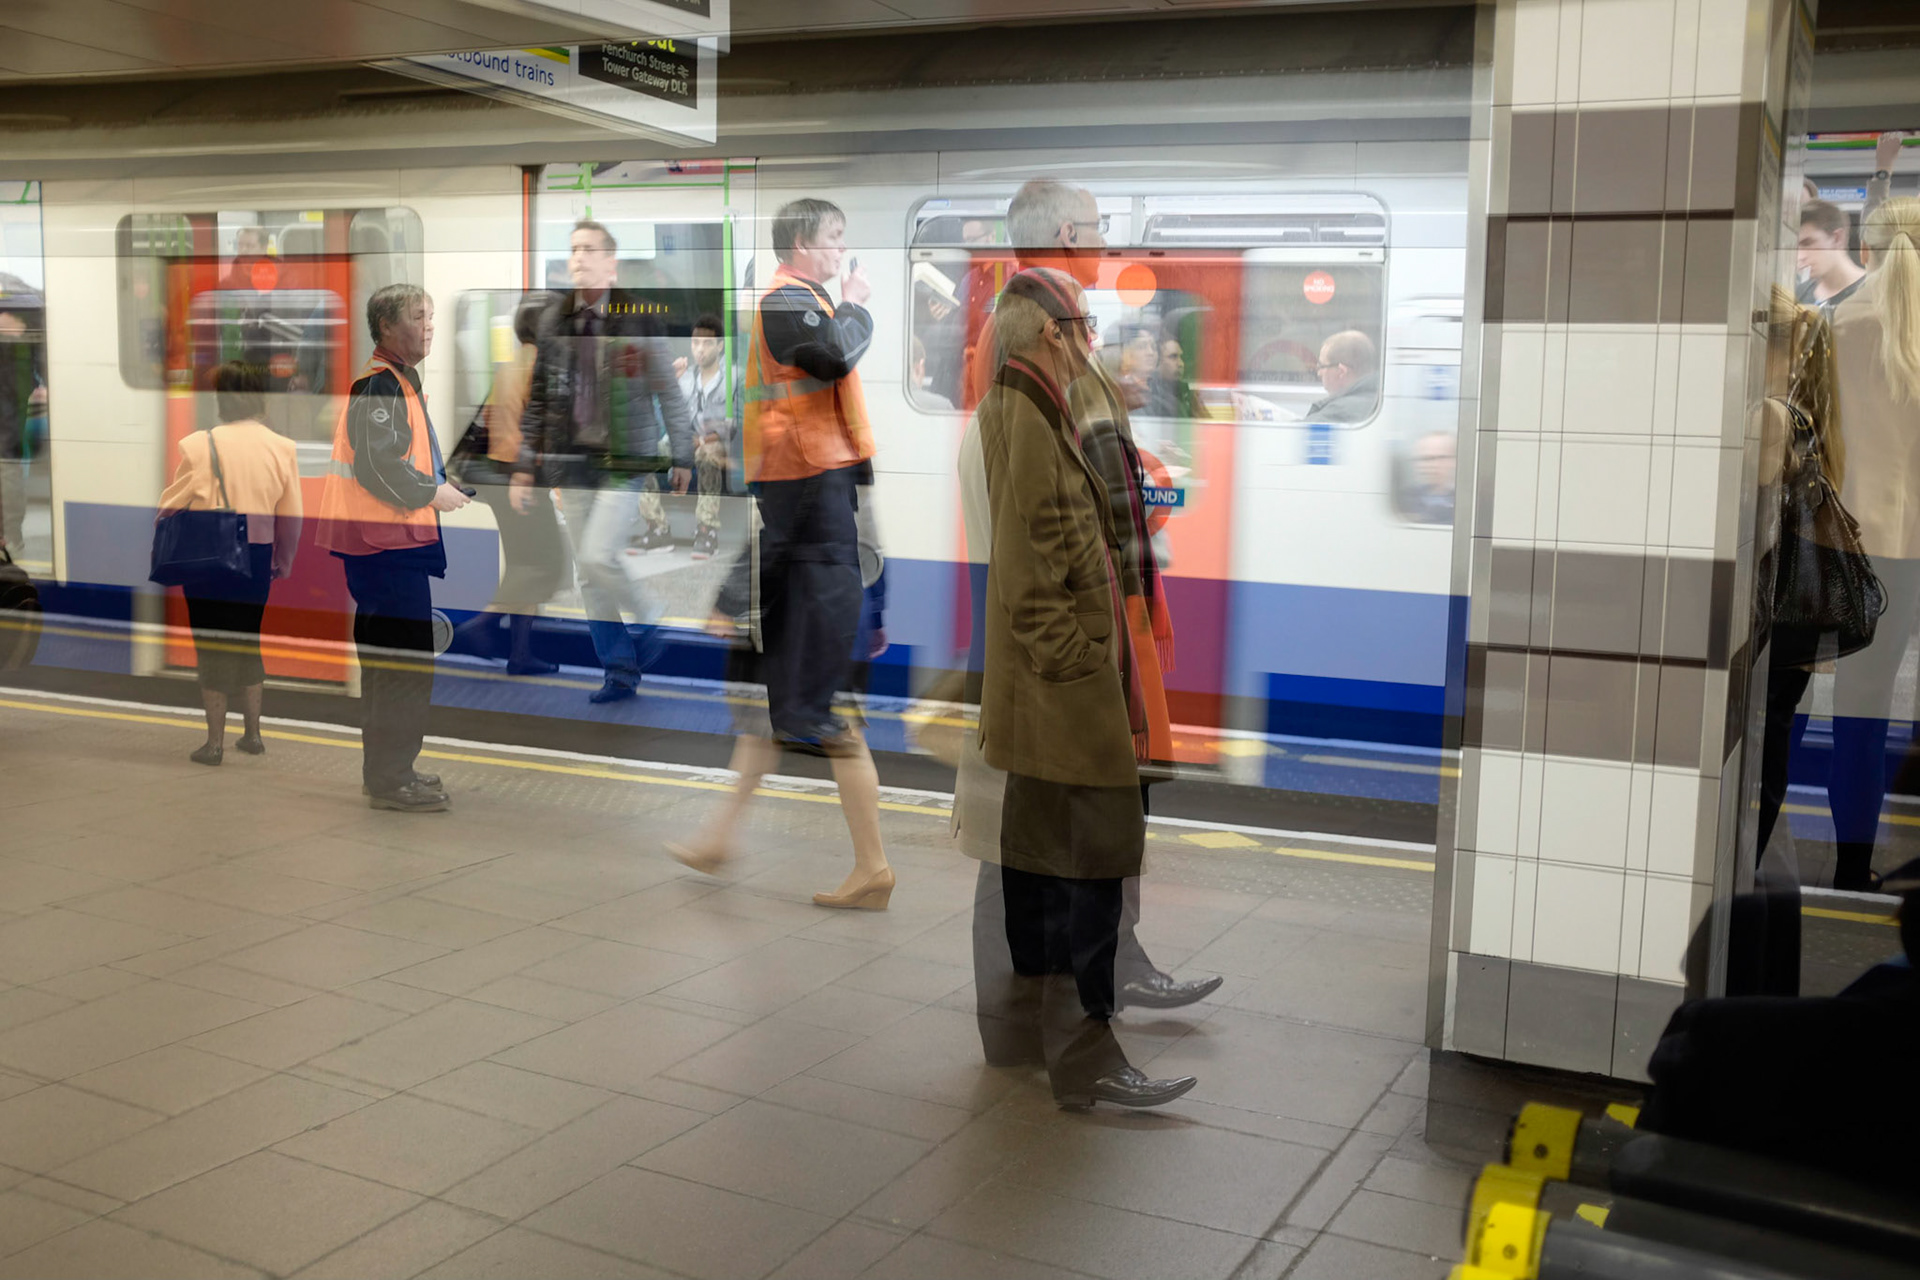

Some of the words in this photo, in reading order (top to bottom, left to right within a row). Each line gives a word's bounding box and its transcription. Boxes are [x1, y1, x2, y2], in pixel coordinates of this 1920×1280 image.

[515, 59, 554, 86] trains
[602, 56, 630, 77] Tower
[631, 66, 670, 92] Gateway
[671, 78, 688, 96] DLR
[648, 54, 676, 76] Street
